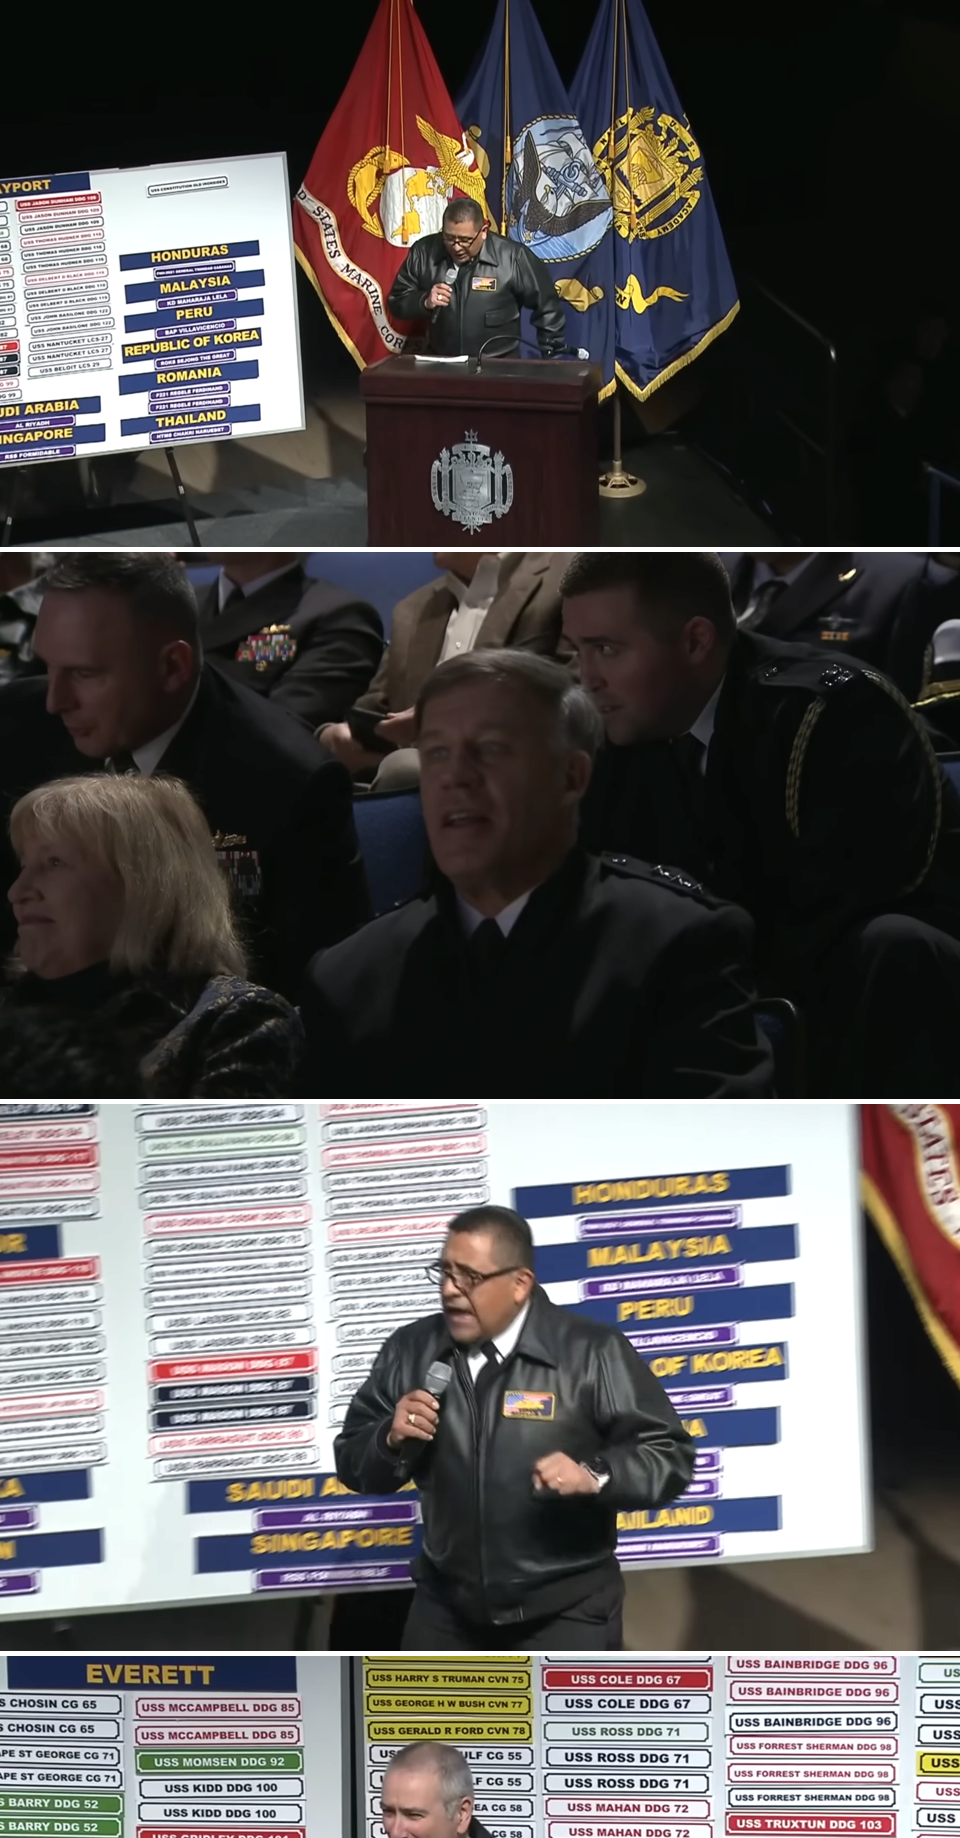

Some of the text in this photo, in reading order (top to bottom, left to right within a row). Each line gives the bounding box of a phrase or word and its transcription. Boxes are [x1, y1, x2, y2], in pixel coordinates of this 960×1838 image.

[656, 201, 693, 237] ACADEMY
[151, 244, 229, 264] HONDURAS
[313, 206, 341, 259] STATES
[341, 263, 383, 316] MARINE
[160, 275, 230, 293] MALAYSIA
[177, 296, 211, 305] MAHARAJA
[176, 306, 212, 320] PERU
[125, 330, 259, 356] REPUBLIC OF KOREA
[157, 367, 221, 383] ROMANIA
[25, 398, 79, 414] ARABIA
[156, 410, 226, 428] THAILAND
[572, 1172, 730, 1205] HONDURAS
[587, 1234, 732, 1267] MALAYSIA
[617, 1296, 694, 1322] PERU
[651, 1346, 783, 1378] OF KOREA
[226, 1478, 315, 1503] SAUDI
[250, 1525, 414, 1555] SINGAPORE
[87, 1664, 214, 1684] EVERETT
[572, 1675, 680, 1684] USS COLE DDG 67
[739, 1687, 889, 1697] USS BAINBRIDGE DDG 96
[253, 1704, 277, 1712] DDG
[281, 1704, 294, 1712] 85
[155, 1758, 284, 1766] USS MOMSEN DDG 92
[165, 1784, 277, 1792] USS KIDD DDG 100
[737, 1819, 882, 1829] USS TRUXTUN DDG 103
